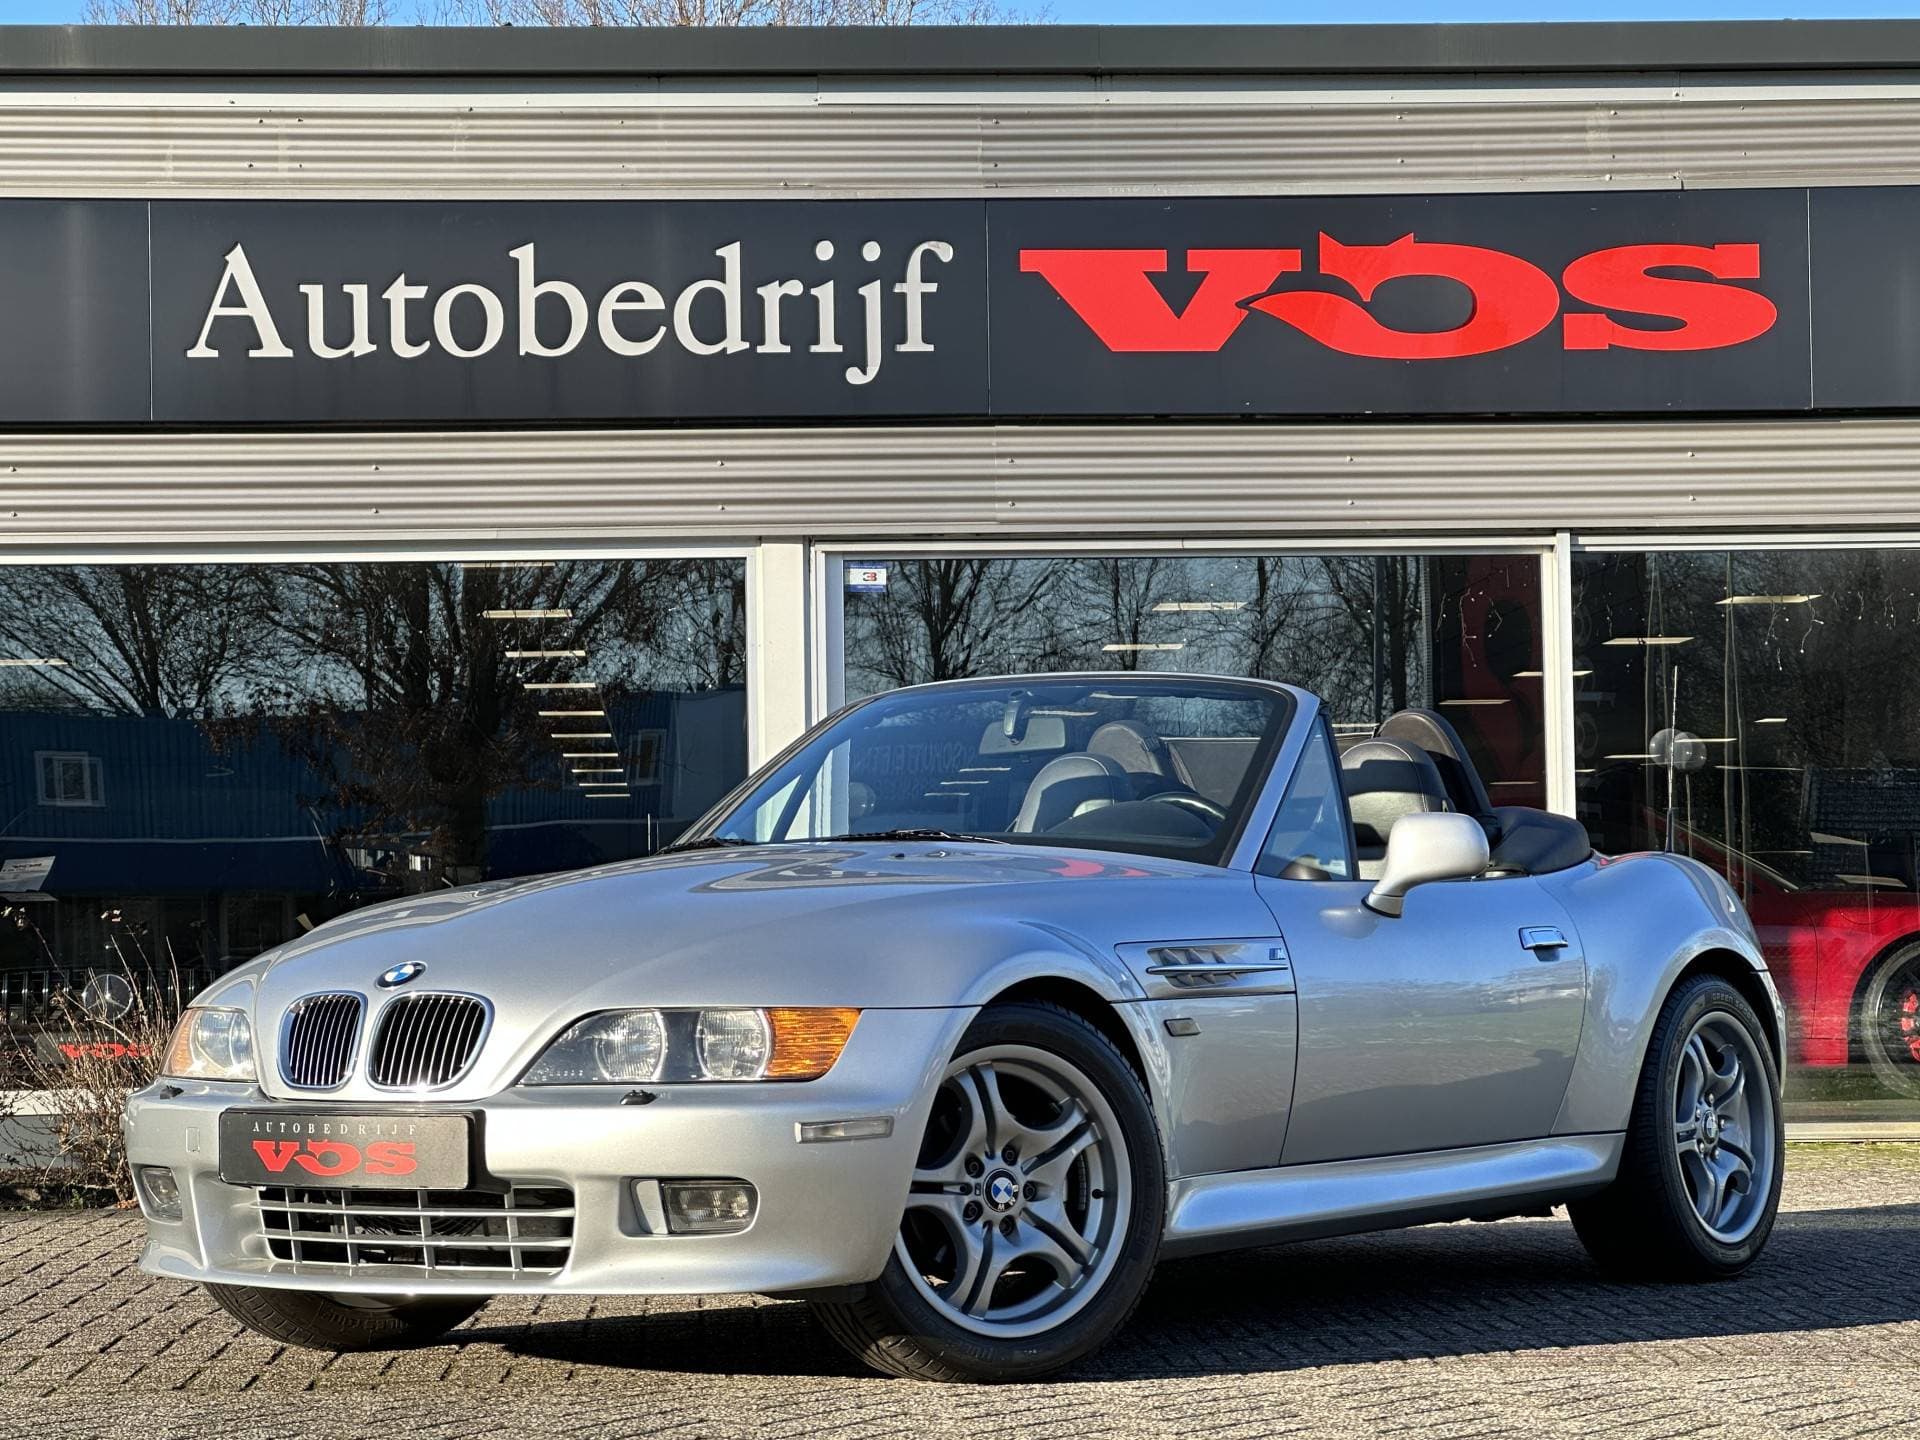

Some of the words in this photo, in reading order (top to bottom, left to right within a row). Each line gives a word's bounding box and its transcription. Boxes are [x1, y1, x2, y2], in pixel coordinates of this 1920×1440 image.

[186, 240, 954, 385] Autobedrijf
[1019, 231, 1777, 360] VOS
[252, 1121, 416, 1136] AUTOBEDRIJF
[252, 1138, 418, 1176] VOS
